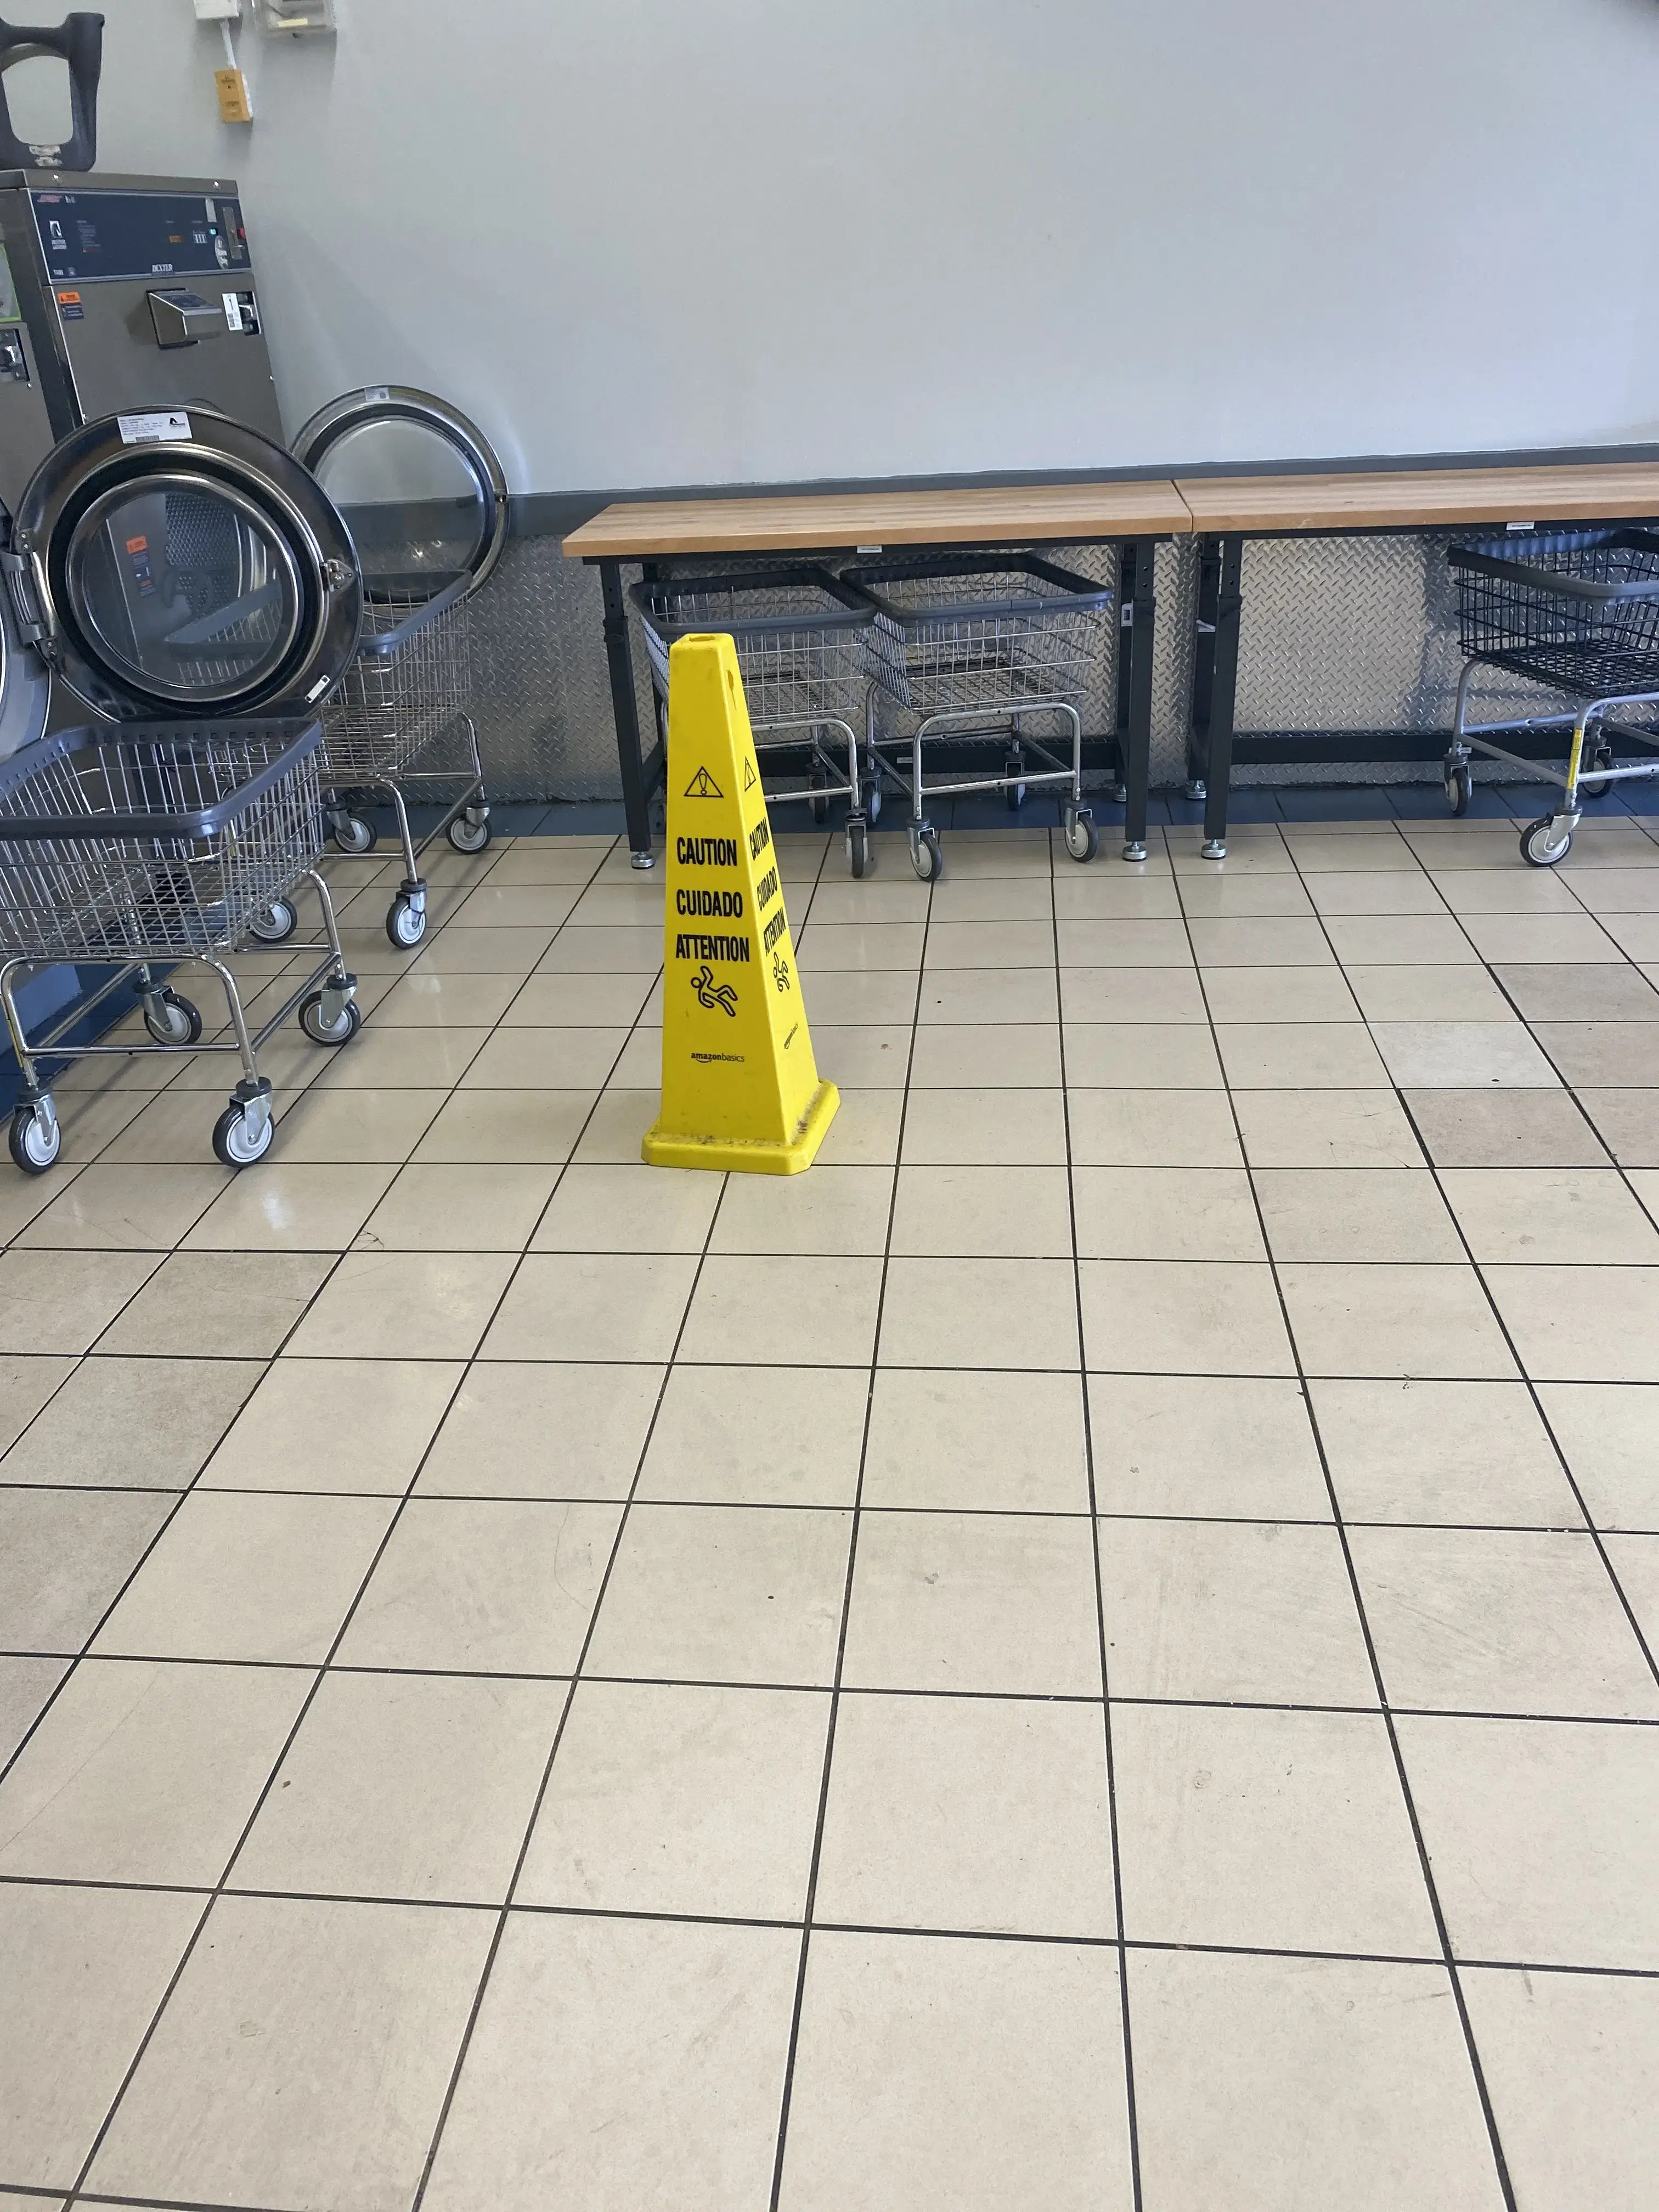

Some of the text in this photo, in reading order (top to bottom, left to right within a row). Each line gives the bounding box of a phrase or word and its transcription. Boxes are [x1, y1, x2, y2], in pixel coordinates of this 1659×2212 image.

[677, 837, 737, 866] CAUTION
[749, 817, 769, 861] CAUTION
[676, 889, 743, 918] CUIDADO
[757, 866, 777, 912] CUIDADO
[763, 906, 786, 957] ATTENTION
[676, 934, 750, 962] ATTENTION
[691, 1052, 745, 1063] amazonbasics
